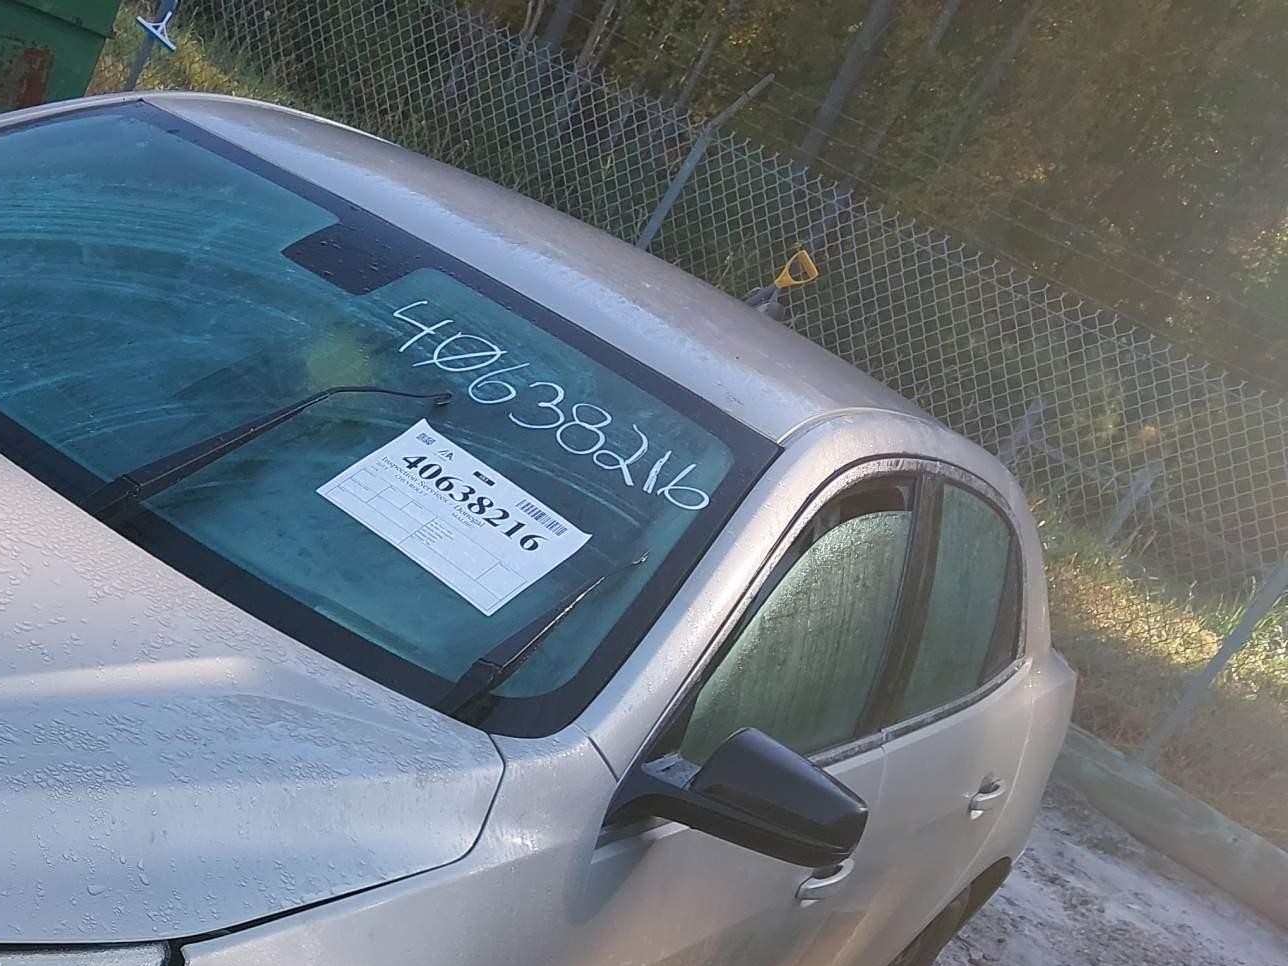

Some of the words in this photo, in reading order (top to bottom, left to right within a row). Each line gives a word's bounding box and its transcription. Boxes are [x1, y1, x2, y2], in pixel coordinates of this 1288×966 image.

[393, 300, 710, 511] 40638216
[381, 456, 418, 482] Inspection
[416, 480, 448, 503] Services
[454, 504, 486, 528] Donegal
[402, 456, 549, 552] 40638216
